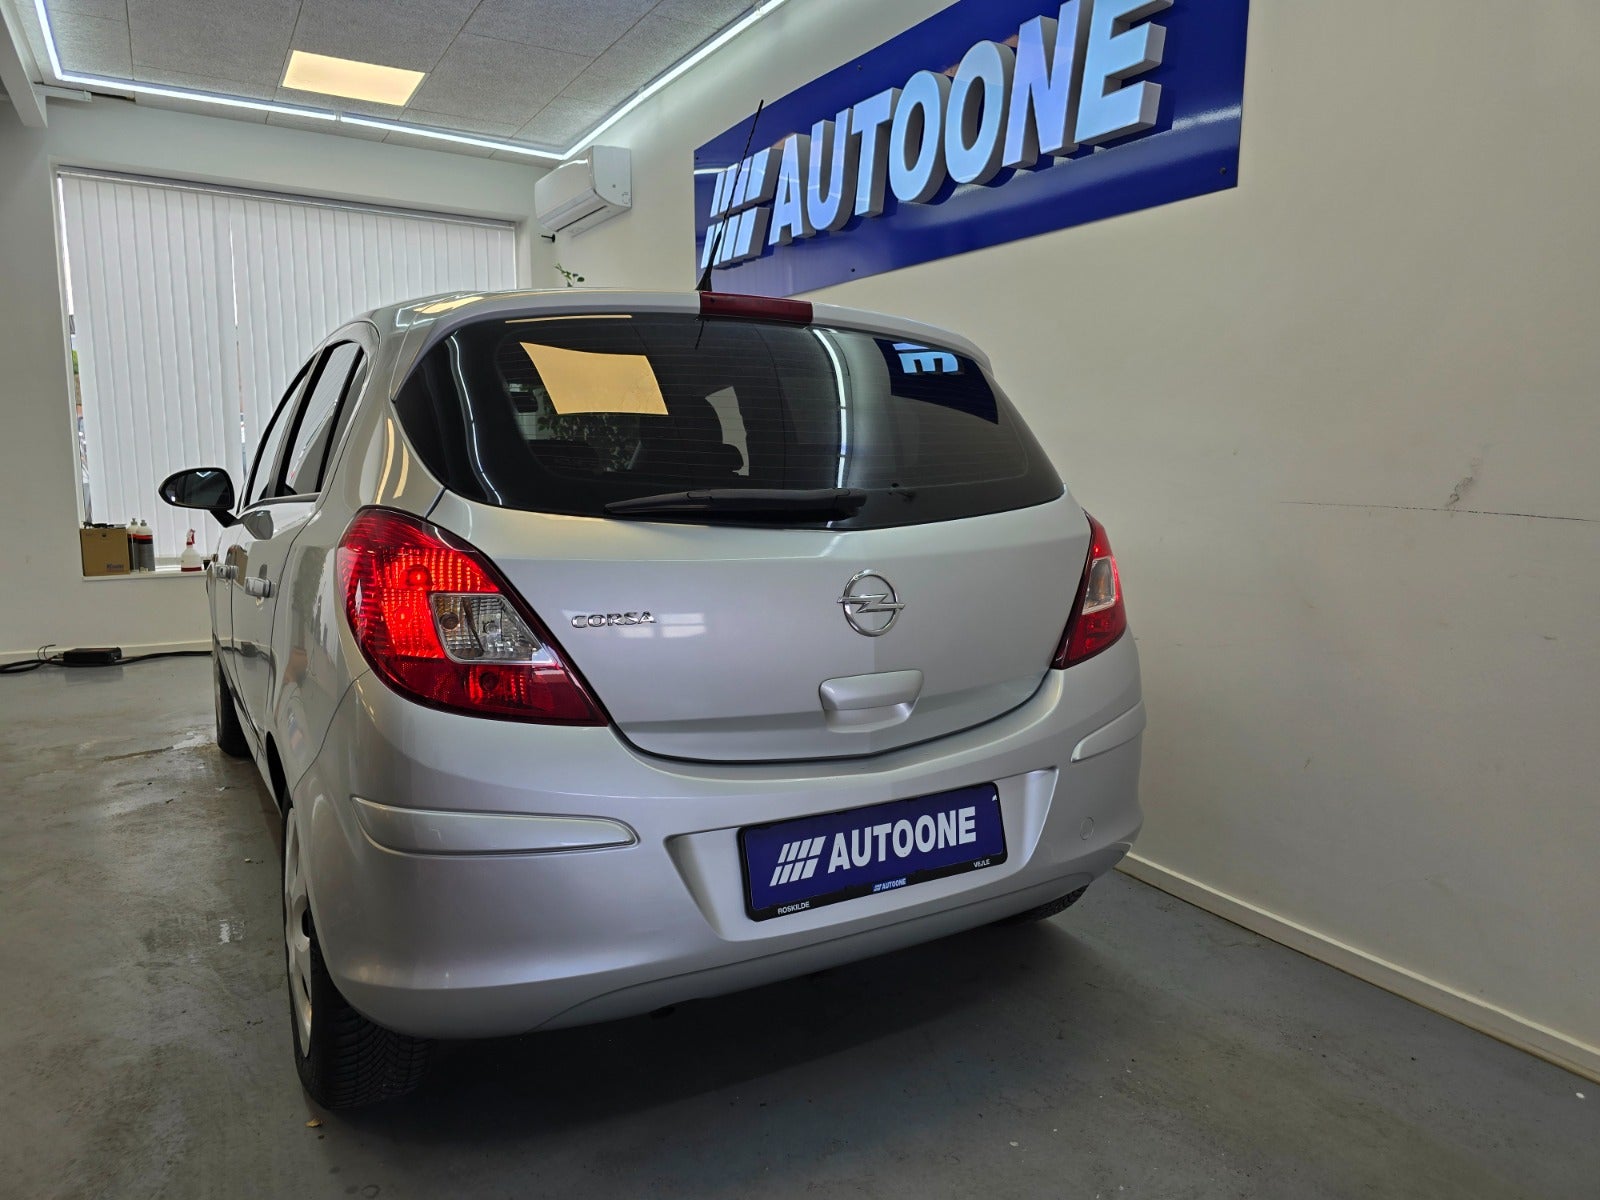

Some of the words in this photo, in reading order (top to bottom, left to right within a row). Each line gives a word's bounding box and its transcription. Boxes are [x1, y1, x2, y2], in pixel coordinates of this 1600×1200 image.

[768, 0, 1171, 246] AUTOONE
[571, 611, 656, 628] CORSA
[827, 806, 977, 874] AUTOONE
[973, 858, 991, 868] VEJLE
[881, 878, 907, 890] AUTOONE
[777, 901, 810, 915] ROSKILDE
